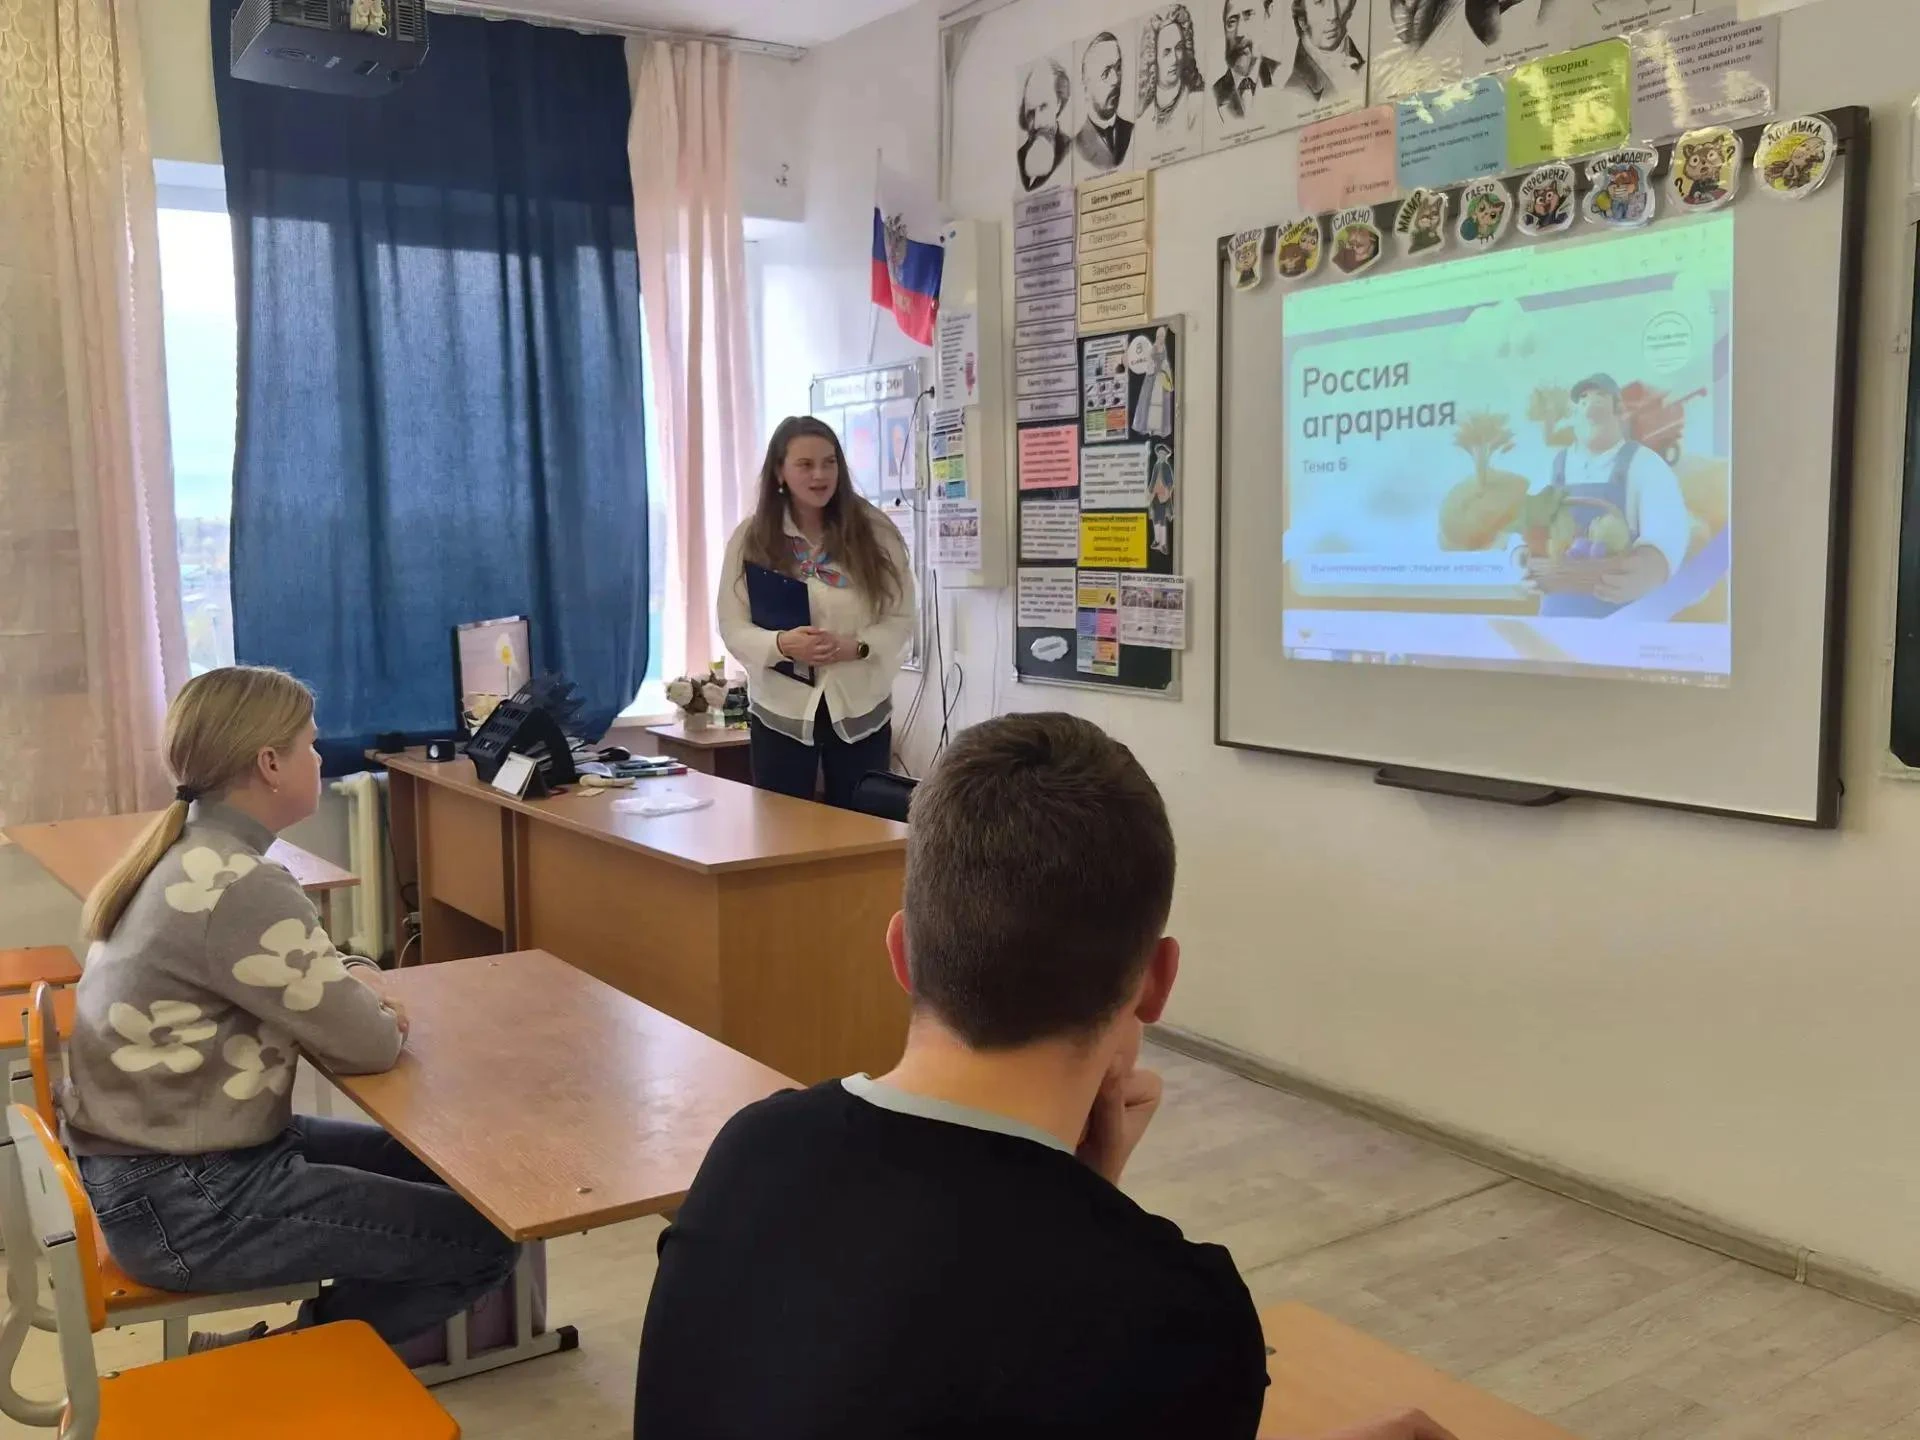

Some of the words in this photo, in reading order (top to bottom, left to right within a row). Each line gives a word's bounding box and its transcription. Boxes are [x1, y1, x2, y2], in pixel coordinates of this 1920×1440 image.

[1691, 19, 1738, 38] сознатель
[1767, 120, 1822, 145] ДОАШКА
[1591, 159, 1607, 174] КТО
[1333, 209, 1371, 231] СЛОЖНО
[1303, 361, 1410, 398] Россия
[1303, 400, 1456, 445] аграрная
[1302, 459, 1334, 474] Тема
